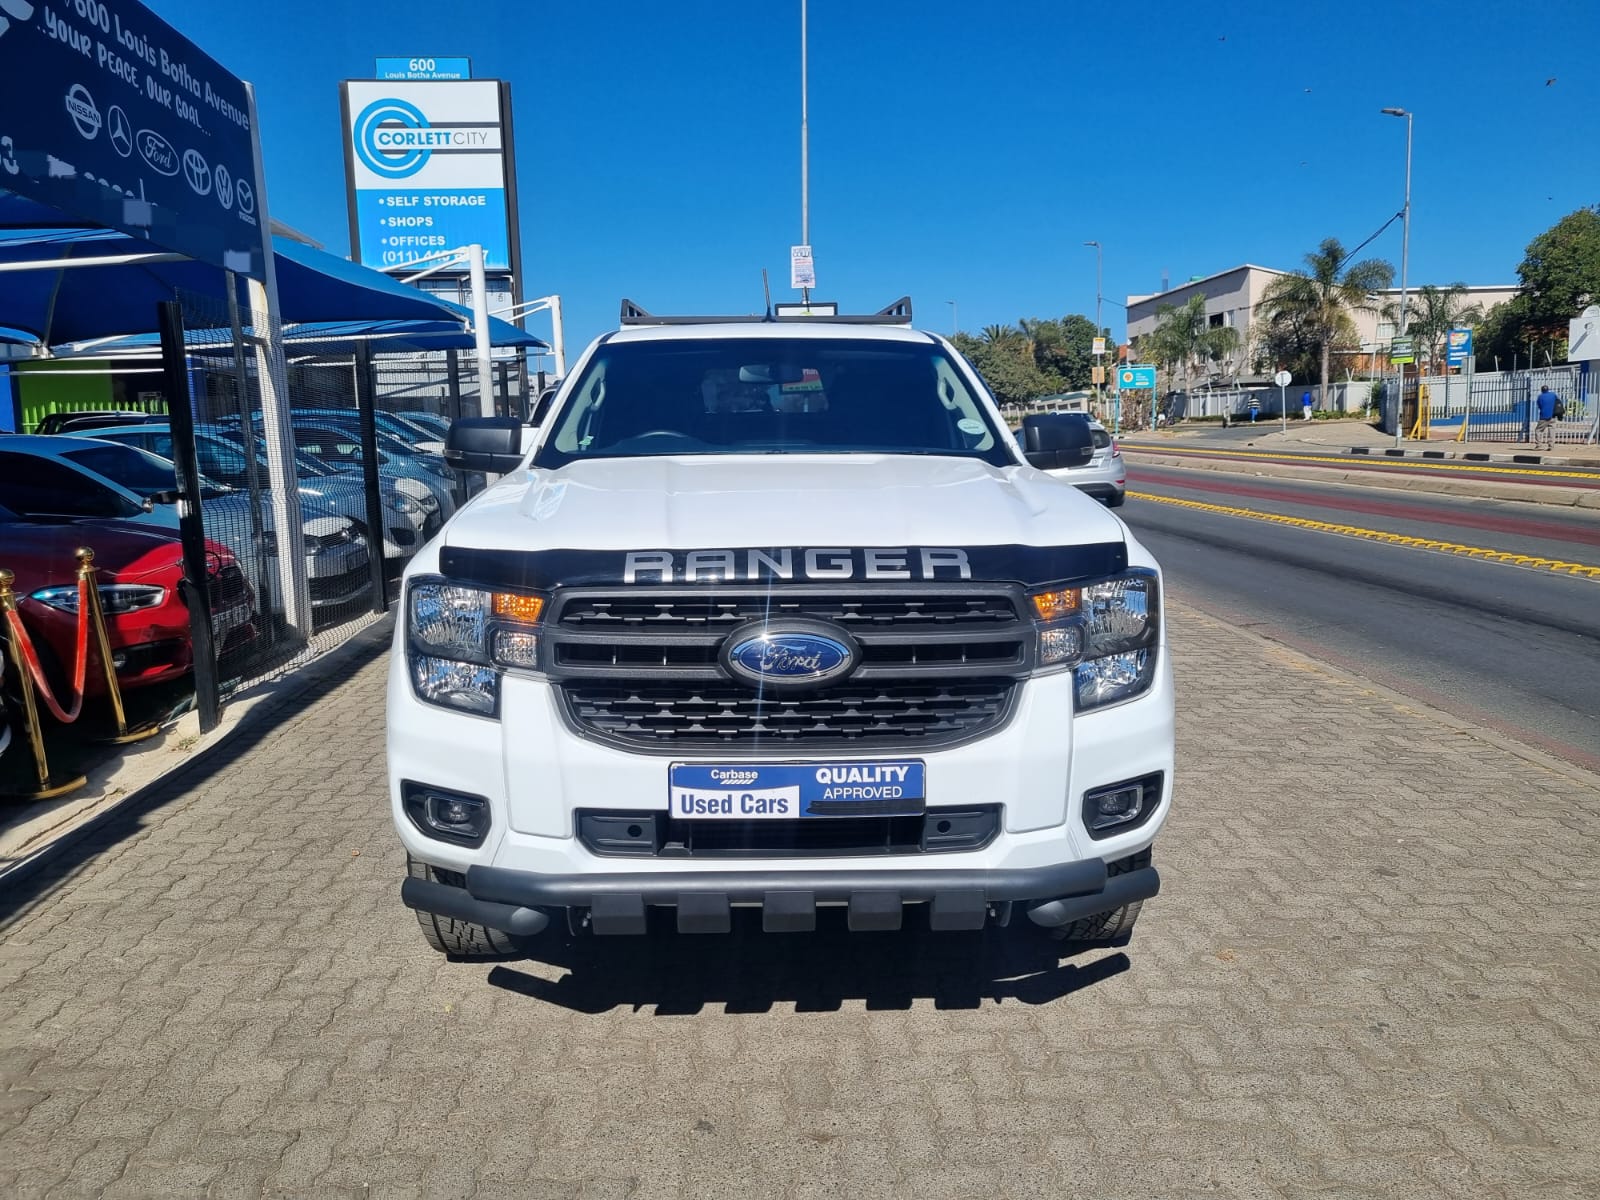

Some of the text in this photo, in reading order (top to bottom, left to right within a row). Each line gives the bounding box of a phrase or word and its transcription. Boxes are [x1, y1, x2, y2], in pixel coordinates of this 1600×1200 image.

[114, 14, 157, 68] Louis
[160, 48, 201, 99] Botha
[205, 81, 250, 131] Avenue
[409, 58, 436, 71] 600
[385, 71, 461, 79] Louis Botha Avenue
[146, 75, 172, 110] OUR
[68, 100, 101, 124] NISSAN
[144, 135, 172, 169] Ford
[386, 195, 486, 207] SELF STORAGE
[388, 216, 433, 227] SHOPS
[389, 235, 446, 247] OFFICES
[623, 547, 972, 584] RANGER
[760, 644, 822, 672] Ford
[711, 769, 758, 780] Carbase
[815, 766, 909, 784] QUALITY
[823, 787, 903, 800] APPROVED
[681, 793, 789, 815] Used Cars
